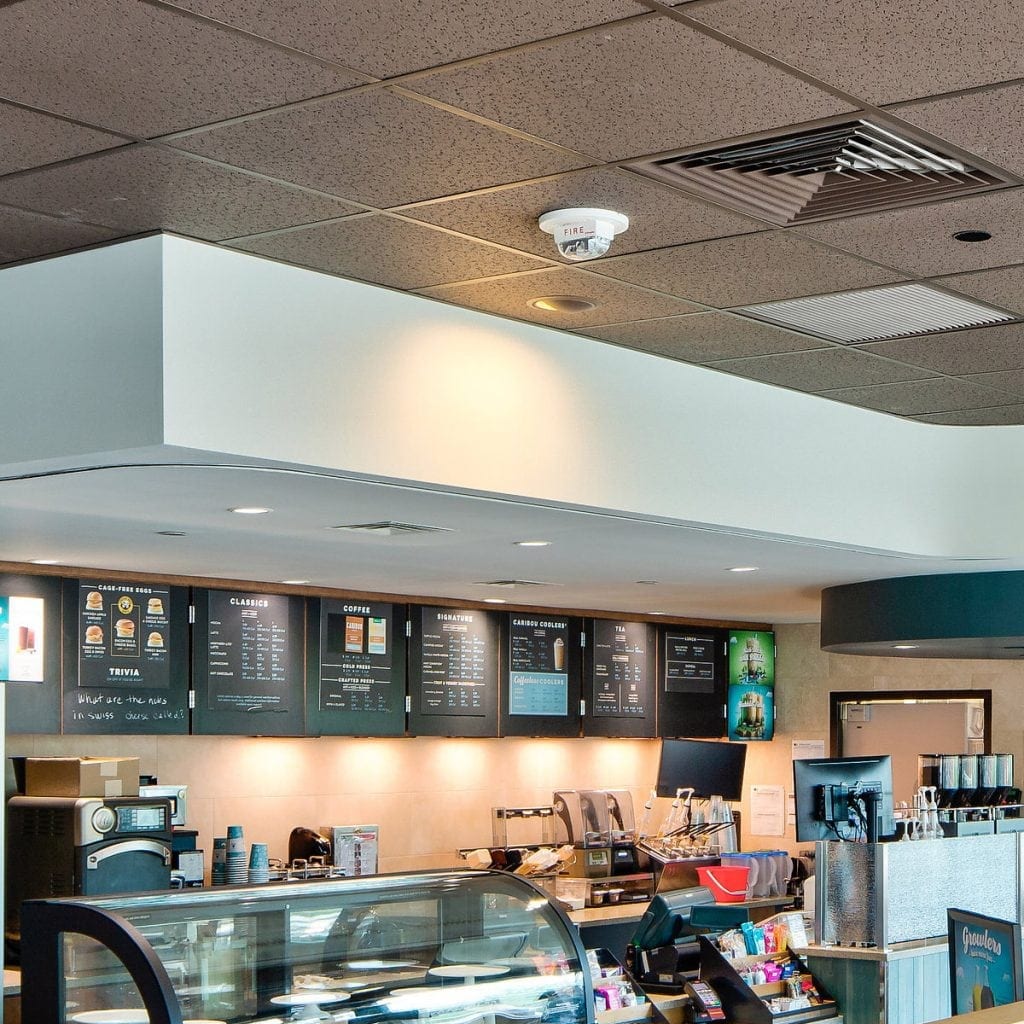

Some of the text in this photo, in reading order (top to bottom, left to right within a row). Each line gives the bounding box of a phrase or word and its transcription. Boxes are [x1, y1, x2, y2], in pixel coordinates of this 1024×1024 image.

[564, 226, 584, 236] FIRE
[98, 585, 134, 593] CAGE-FREE
[230, 598, 269, 607] CLASSICS
[343, 605, 371, 614] COFFEE
[437, 613, 473, 622] SIGNATURE
[512, 619, 538, 627] CARIBOU
[109, 668, 140, 676] TRIVIA
[78, 692, 104, 704] What
[126, 695, 145, 704] the
[73, 710, 84, 719] in
[88, 711, 114, 720] swiss
[962, 926, 1002, 956] Growlers
